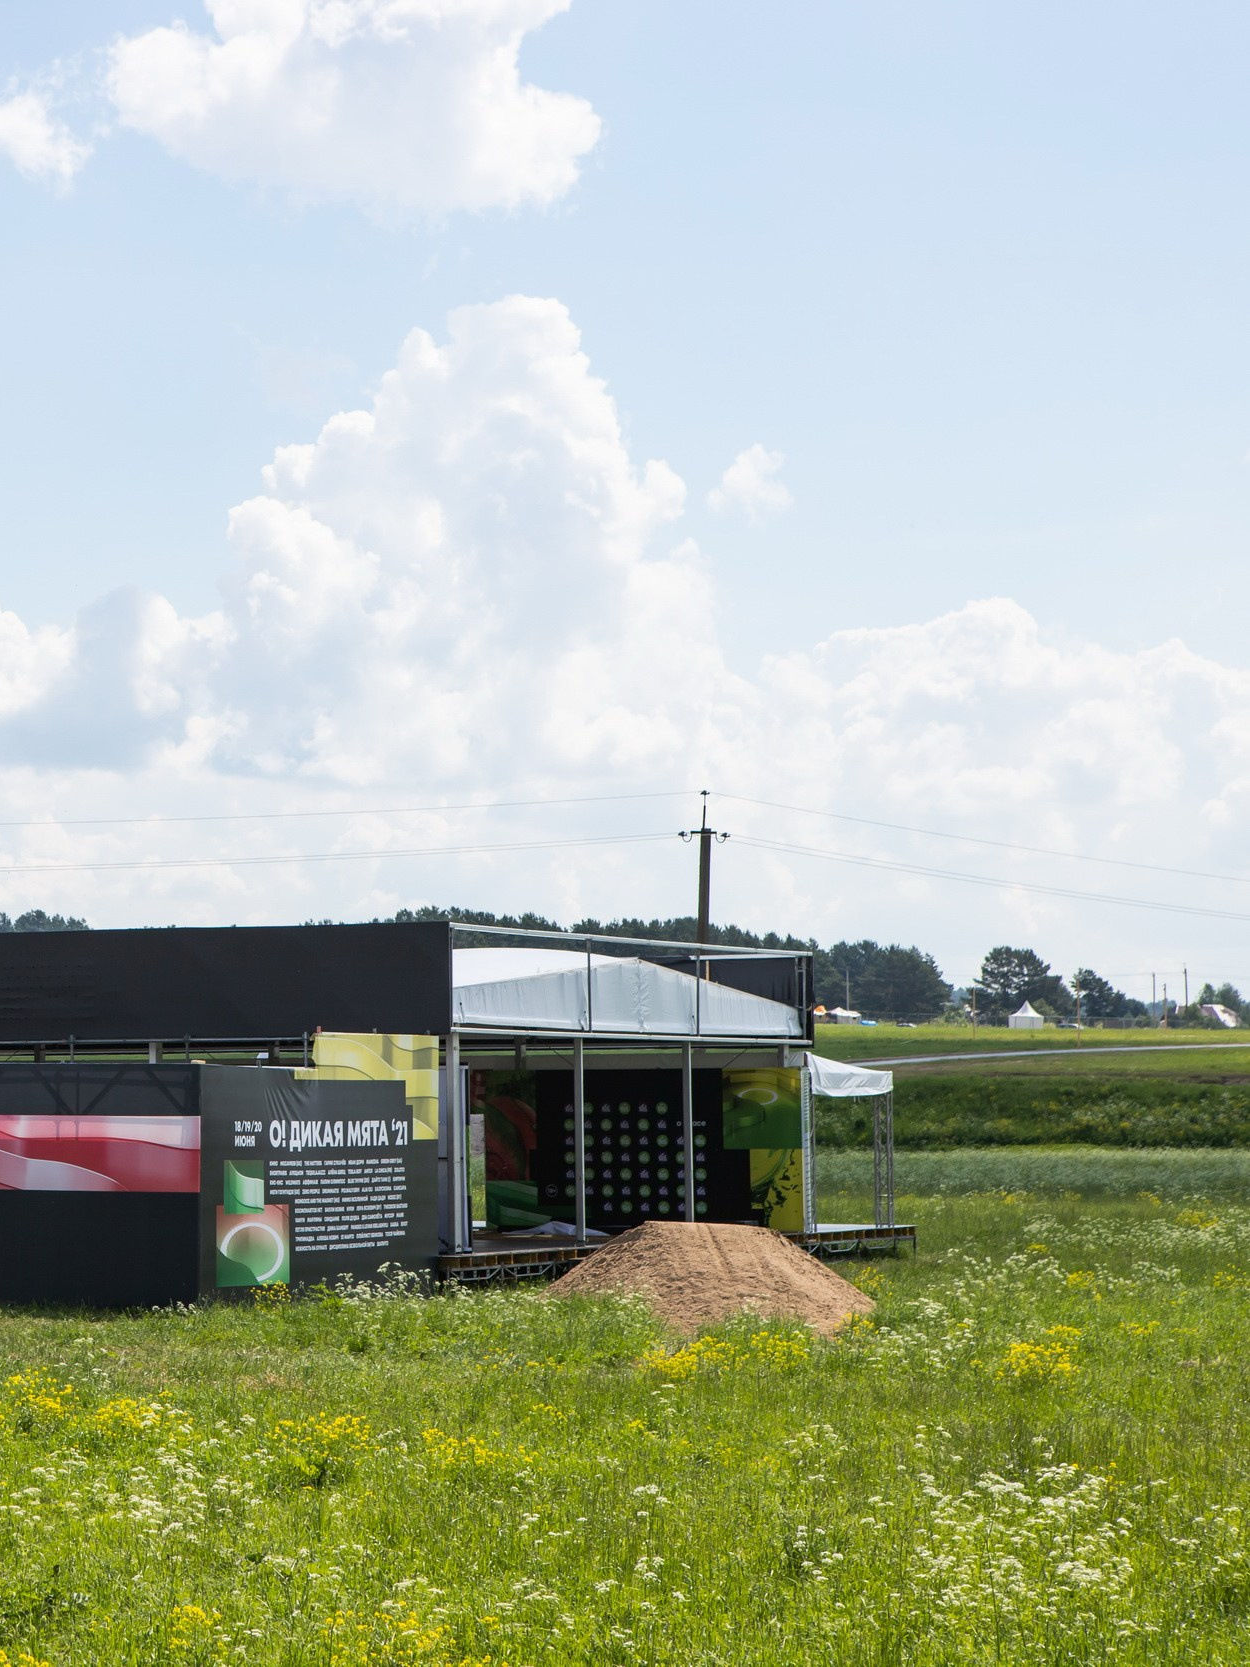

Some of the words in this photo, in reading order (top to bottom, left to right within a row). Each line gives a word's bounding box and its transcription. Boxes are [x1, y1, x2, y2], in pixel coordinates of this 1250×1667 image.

[234, 1120, 262, 1133] 18/19/20
[234, 1135, 256, 1147] ИЮНЯ
[269, 1120, 286, 1148] О!
[289, 1120, 344, 1152] ДИКАЯ
[347, 1120, 389, 1147] МЯТА
